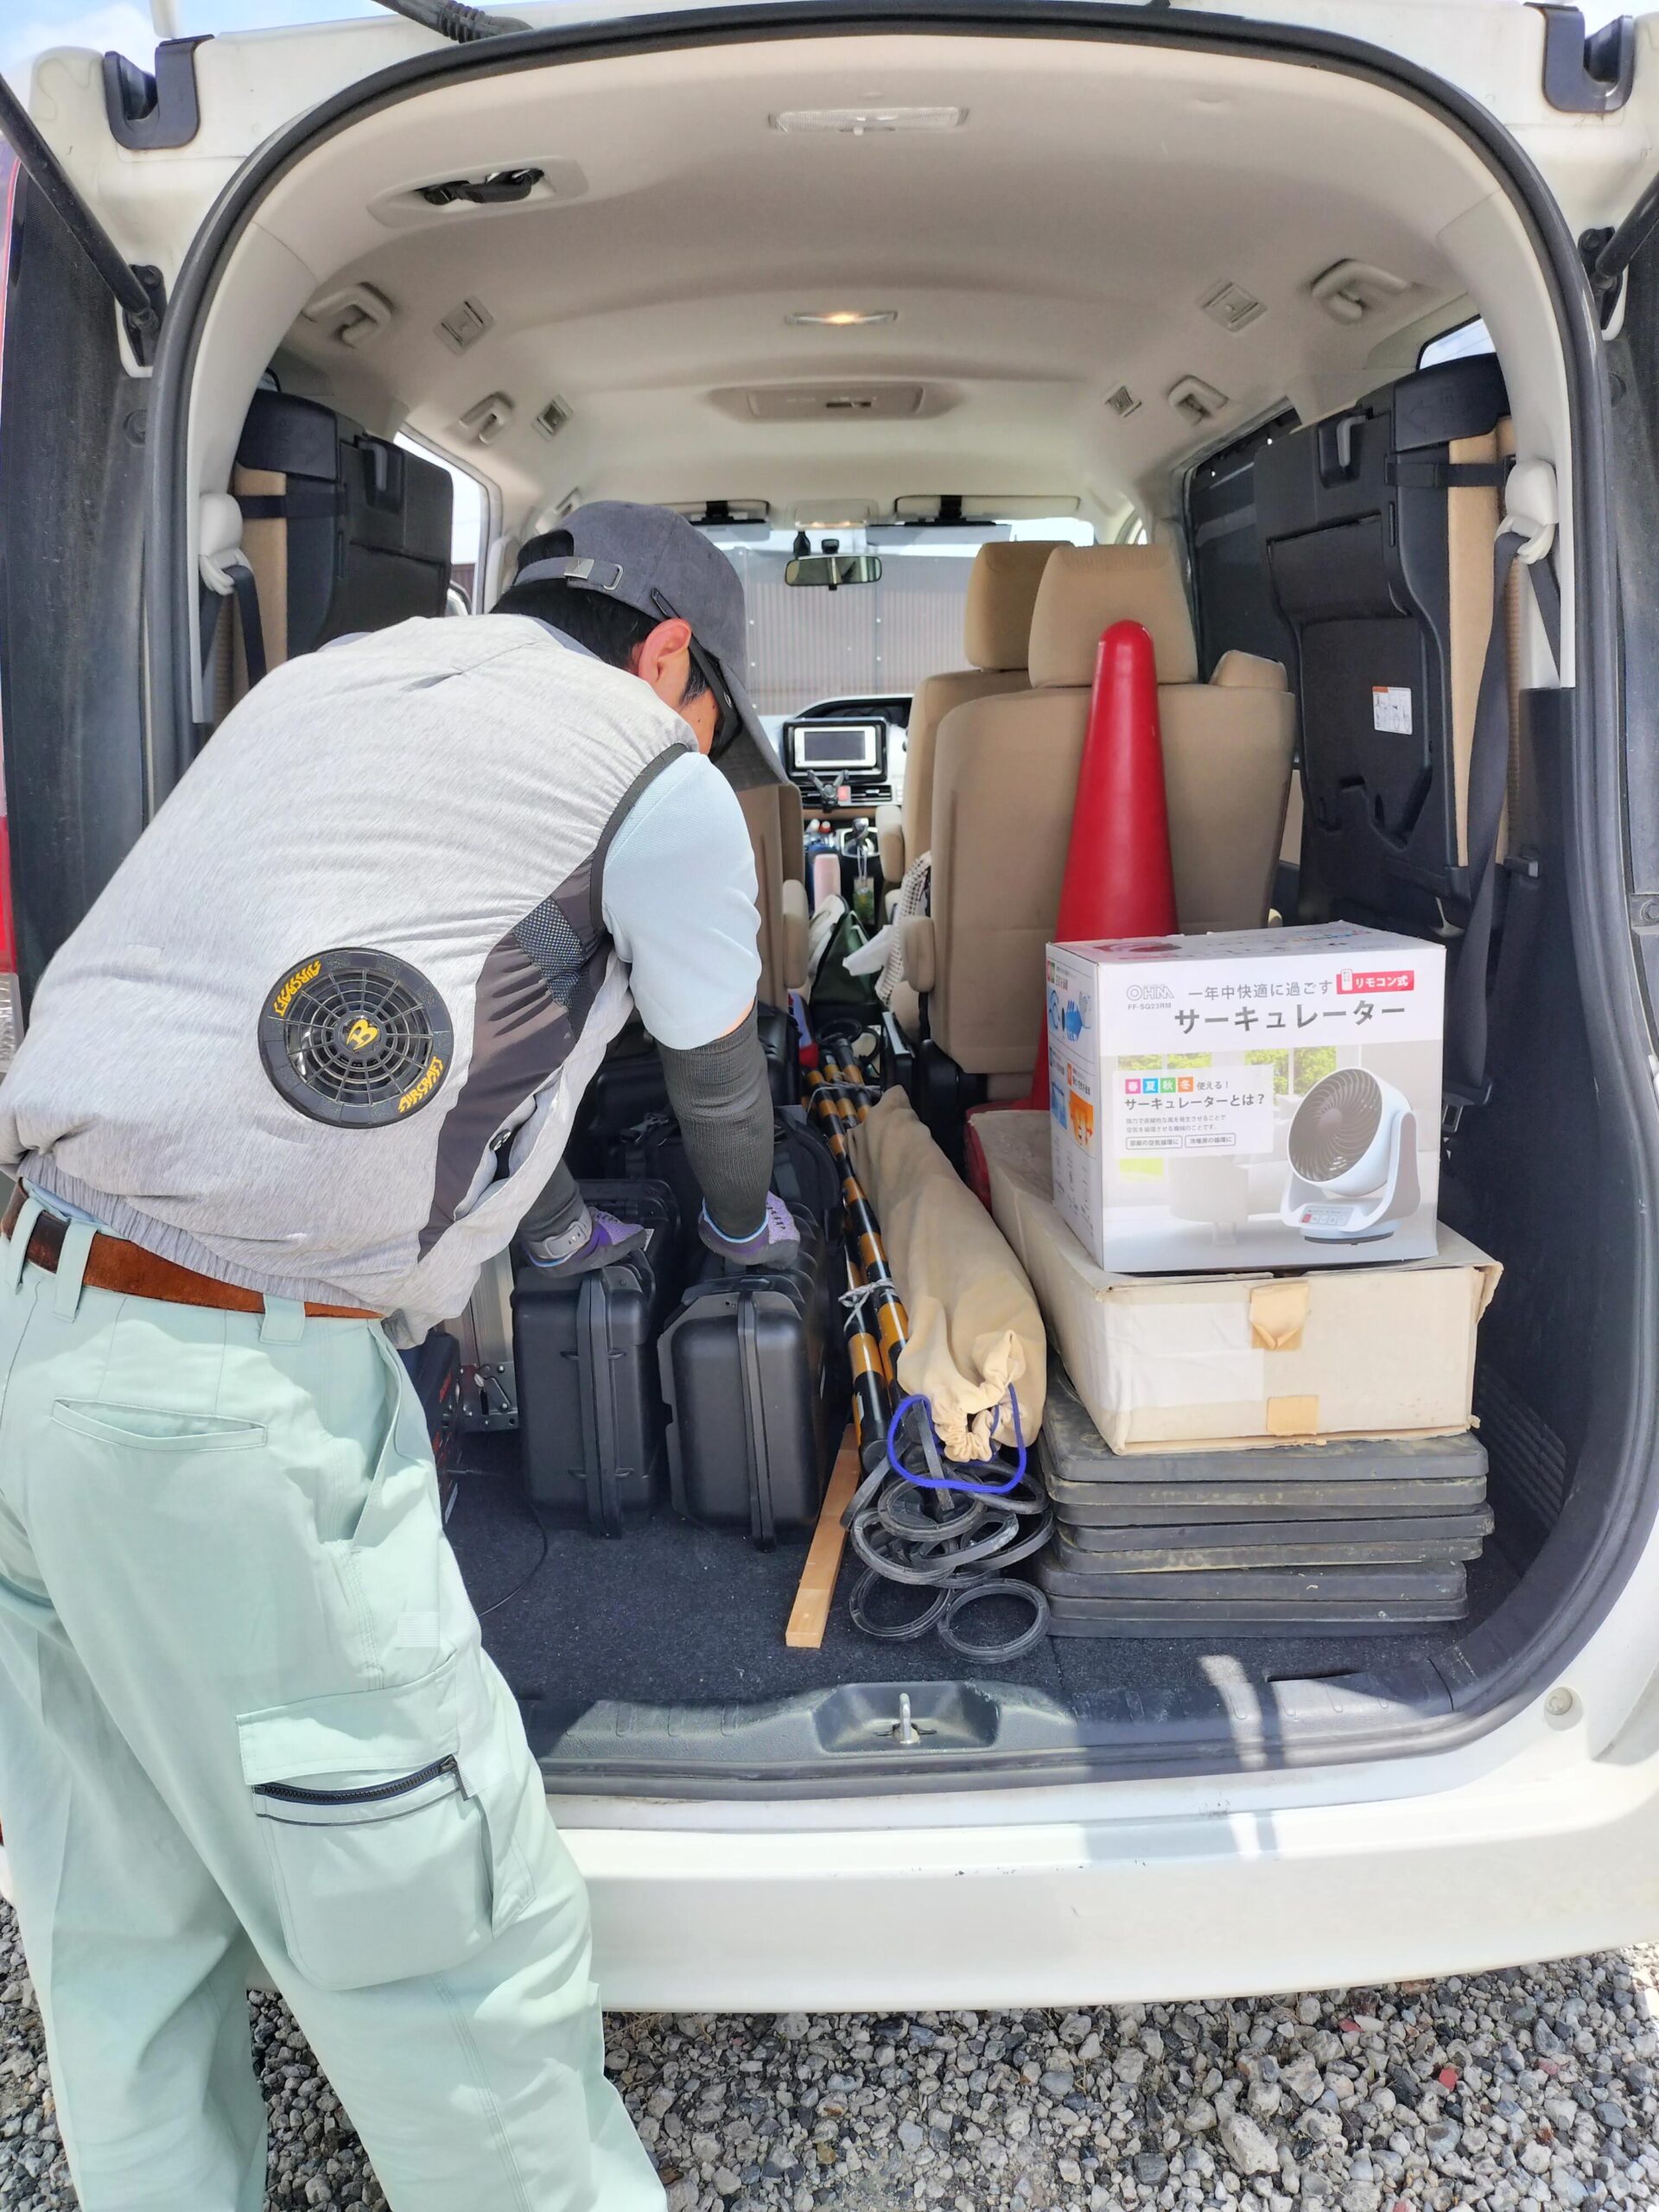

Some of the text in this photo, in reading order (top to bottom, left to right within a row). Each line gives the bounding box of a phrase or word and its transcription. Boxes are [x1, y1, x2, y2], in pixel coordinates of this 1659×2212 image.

[274, 961, 321, 1016] AIRCRAFT
[1126, 984, 1175, 1001] OHM
[1188, 980, 1332, 1001] 一年中快適に過ごす
[1356, 975, 1408, 989] リモコン式
[1174, 1000, 1405, 1034] サーキュレーター
[346, 1018, 379, 1052] B
[397, 1056, 444, 1112] AIRCRAFT
